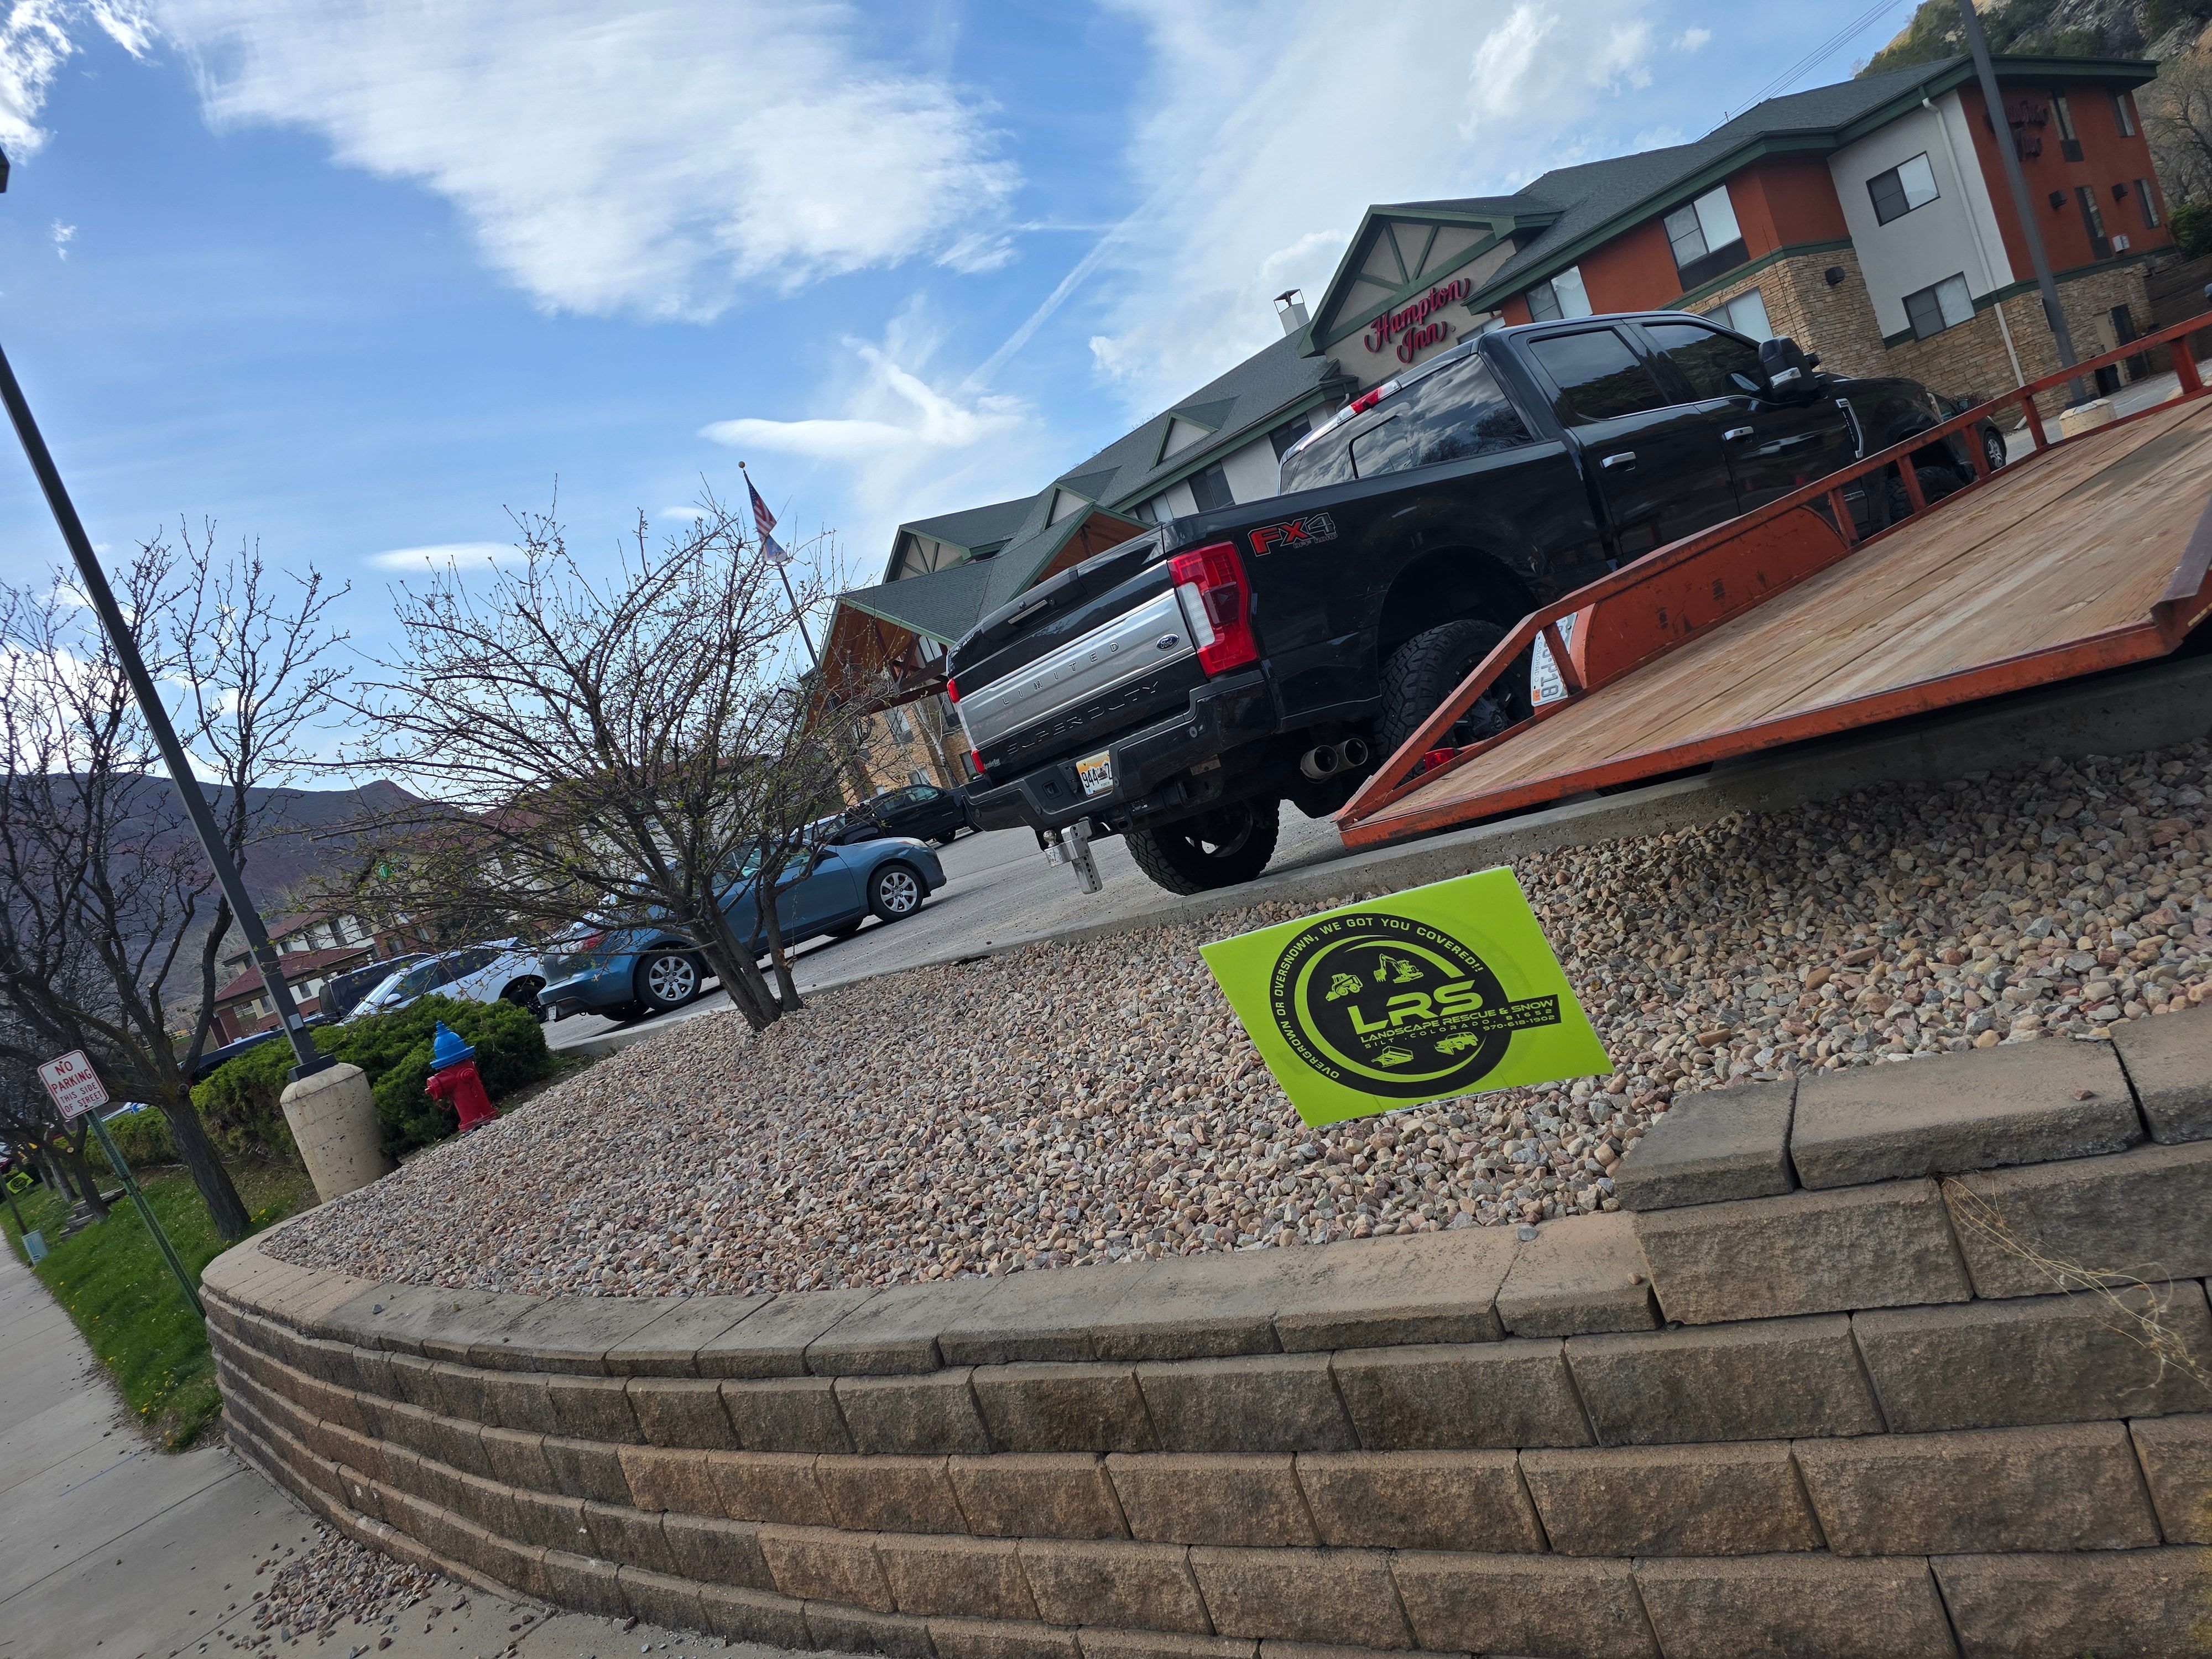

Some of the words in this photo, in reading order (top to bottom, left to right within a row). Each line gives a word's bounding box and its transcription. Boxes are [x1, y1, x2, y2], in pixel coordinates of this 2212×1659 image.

[1364, 278, 1470, 353] Hampton
[1396, 321, 1448, 363] Inn
[1248, 512, 1337, 557] FX4
[1293, 539, 1311, 549] OFF
[1160, 637, 1173, 649] Ford
[1001, 641, 1119, 706] LIMITED
[1006, 716, 1083, 755] SUPER
[1087, 680, 1159, 720] DUTY
[1081, 768, 1099, 788] 944
[1319, 922, 1342, 935] WE
[1346, 917, 1373, 927] GOT
[1380, 918, 1410, 931] YOU
[1416, 927, 1484, 972] COVERED!!
[1274, 934, 1319, 997] OVERSNOWN,
[1275, 1001, 1286, 1016] OR
[1347, 979, 1483, 1035] LRS
[1360, 1020, 1440, 1043] LANDSCAPE
[1442, 1009, 1496, 1025] RESCUE
[1511, 999, 1553, 1013] SNOW
[1365, 1037, 1395, 1048] SILT
[1506, 1009, 1553, 1020] 81652
[1483, 1015, 1556, 1031] 970-618-1902
[1280, 1021, 1340, 1079] OVERGROWN
[54, 1061, 73, 1076] NO
[51, 1069, 92, 1094] PARKING
[59, 1092, 77, 1104] THIS
[80, 1082, 98, 1094] SIDE
[64, 1104, 74, 1113] OF
[77, 1091, 103, 1107] STREET
